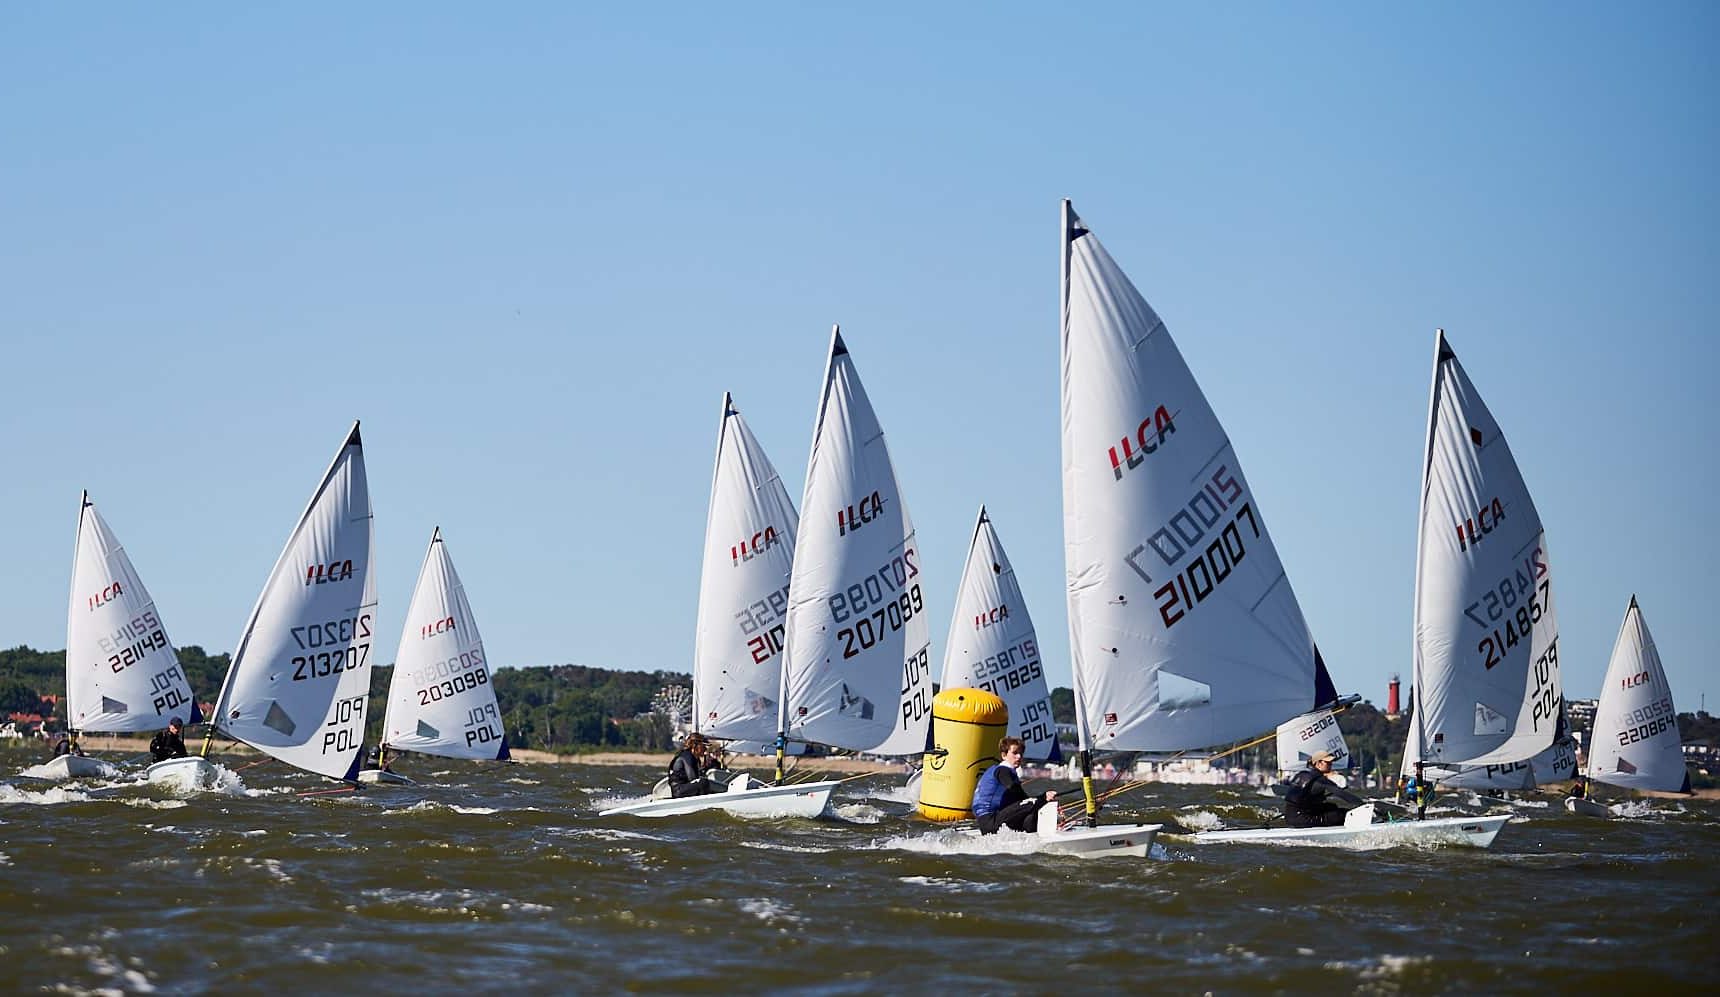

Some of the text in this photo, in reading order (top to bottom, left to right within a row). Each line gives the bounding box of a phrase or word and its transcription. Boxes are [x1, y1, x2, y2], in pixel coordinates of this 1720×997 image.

[1108, 404, 1177, 481] ILCA
[837, 490, 883, 536] ILCA
[1456, 496, 1506, 553] ILCA
[731, 525, 780, 567] ILCA
[305, 560, 353, 586] ILCA
[1153, 502, 1260, 628] 210007
[89, 582, 123, 611] ILCA
[422, 617, 455, 640] ILCA
[837, 583, 923, 660] 207099
[975, 604, 1009, 631] ILCA
[1478, 579, 1550, 671] 214857
[108, 630, 166, 673] 221149
[291, 643, 370, 681] 213207
[747, 623, 786, 664] 210
[417, 668, 488, 705] 203098
[1622, 671, 1650, 691] ILCA
[153, 688, 190, 716] POL
[902, 687, 931, 730] POL
[1532, 683, 1560, 732] POL
[322, 728, 359, 755] POL
[465, 725, 502, 747] POL
[1022, 722, 1053, 744] POL
[1300, 715, 1335, 741] 222012
[1618, 714, 1675, 746] 220864
[1552, 758, 1575, 774] POL
